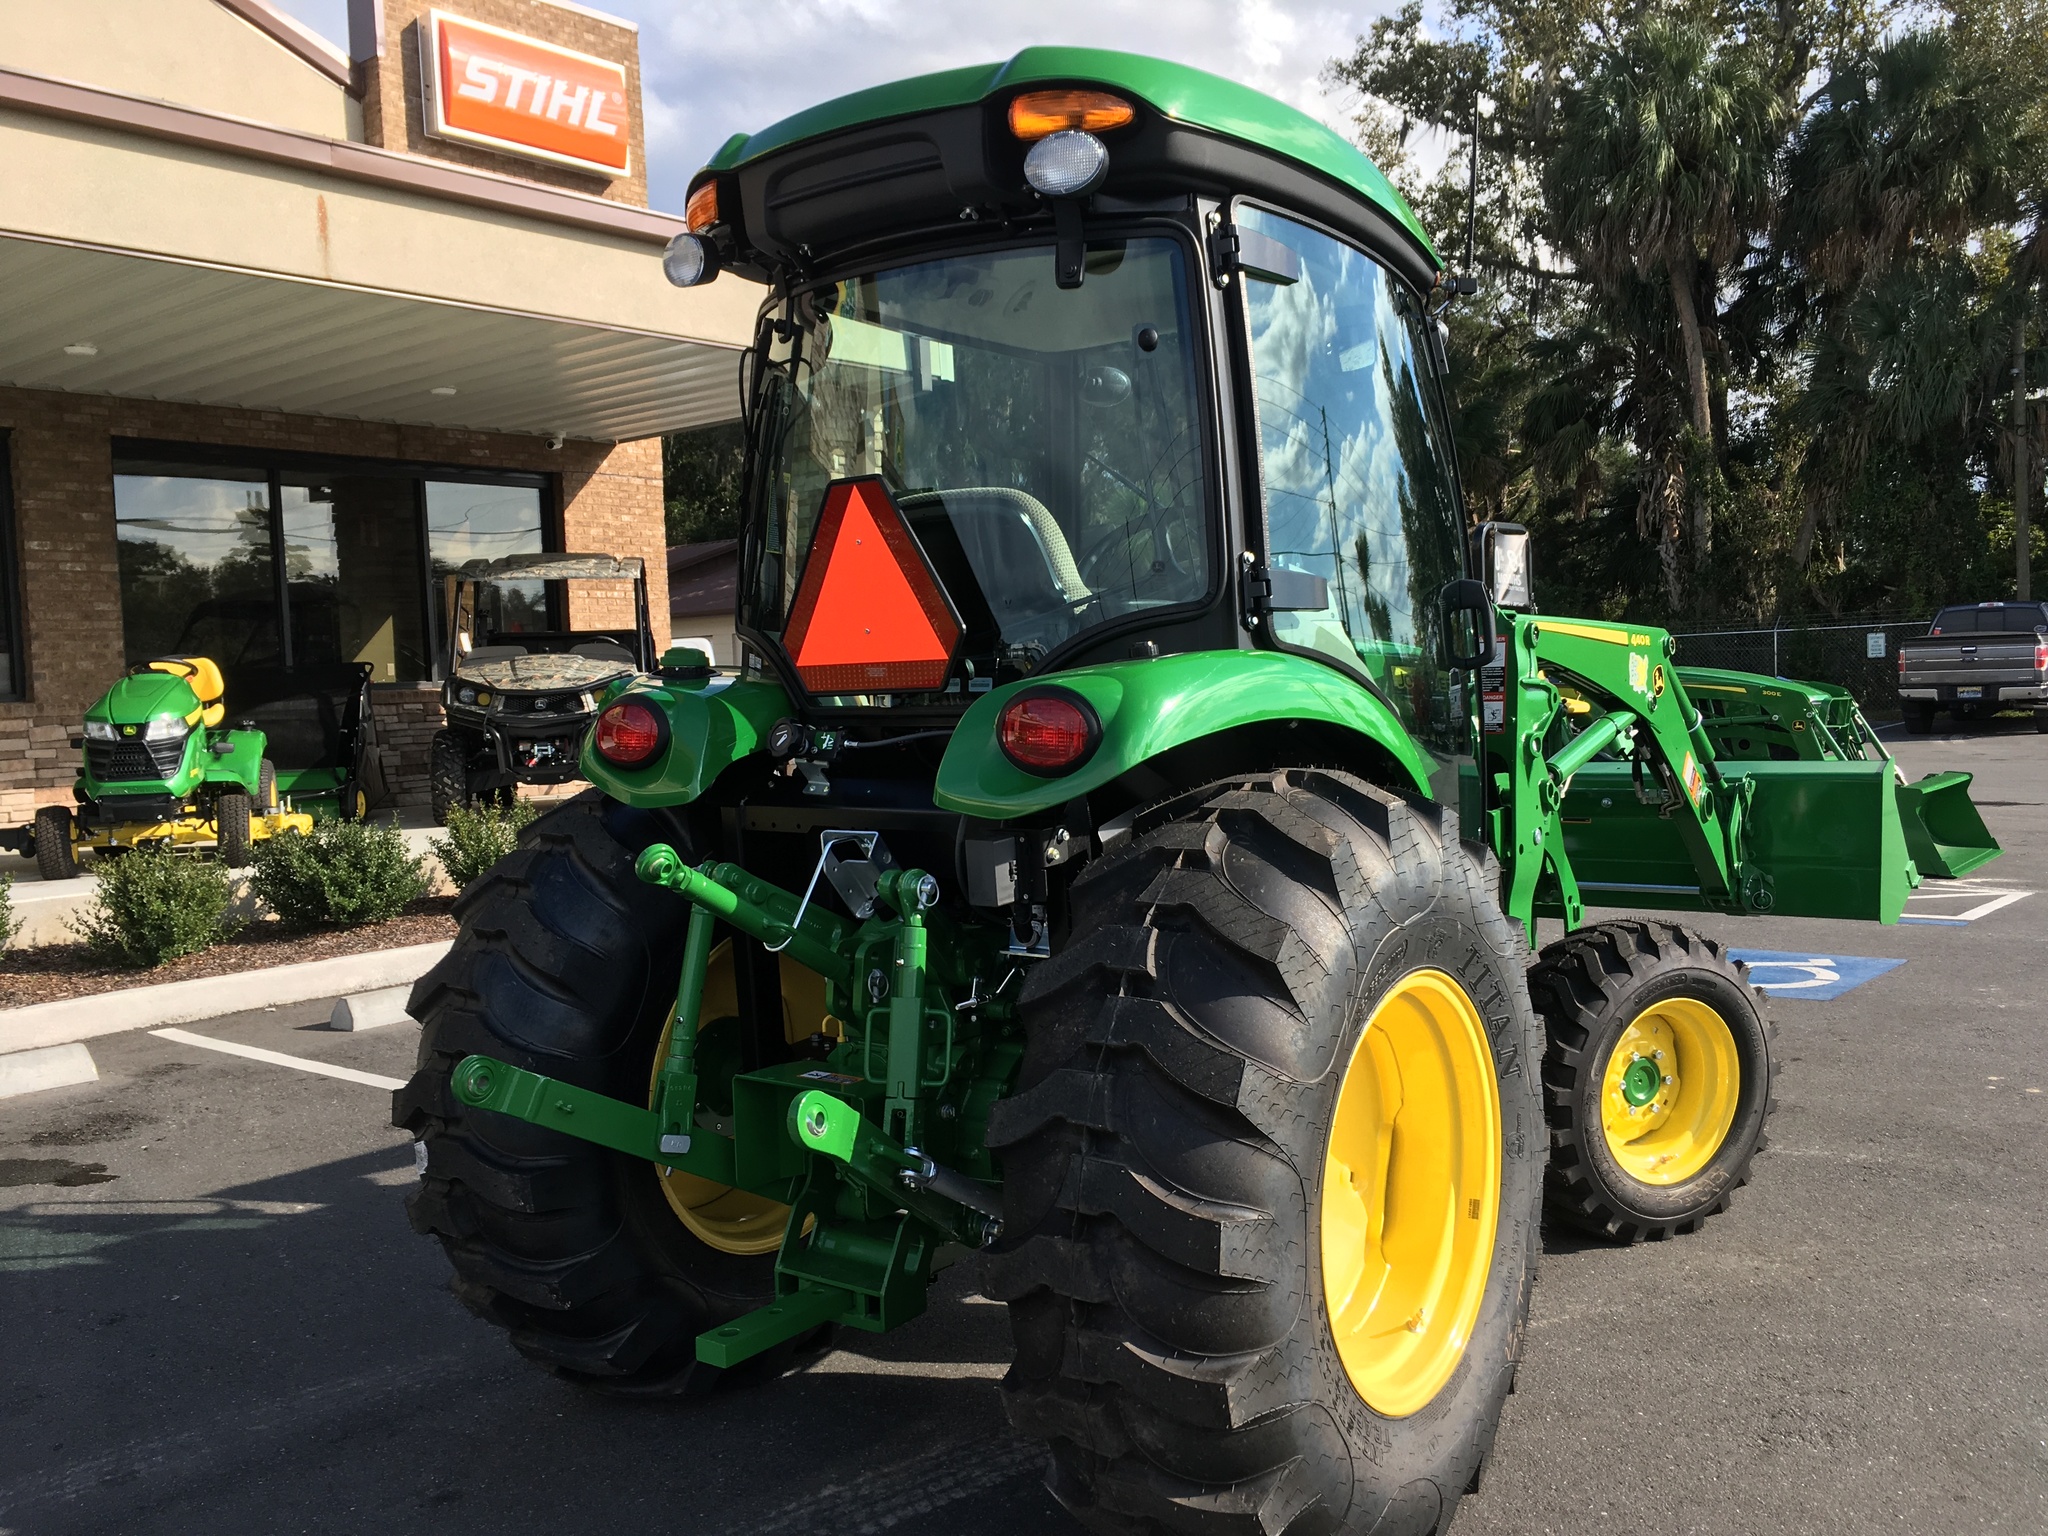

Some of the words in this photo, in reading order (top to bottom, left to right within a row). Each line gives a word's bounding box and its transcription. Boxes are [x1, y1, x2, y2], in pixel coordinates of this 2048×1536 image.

[458, 55, 618, 136] STIHL
[1631, 634, 1650, 646] 440R
[1457, 940, 1524, 1079] TITAN
